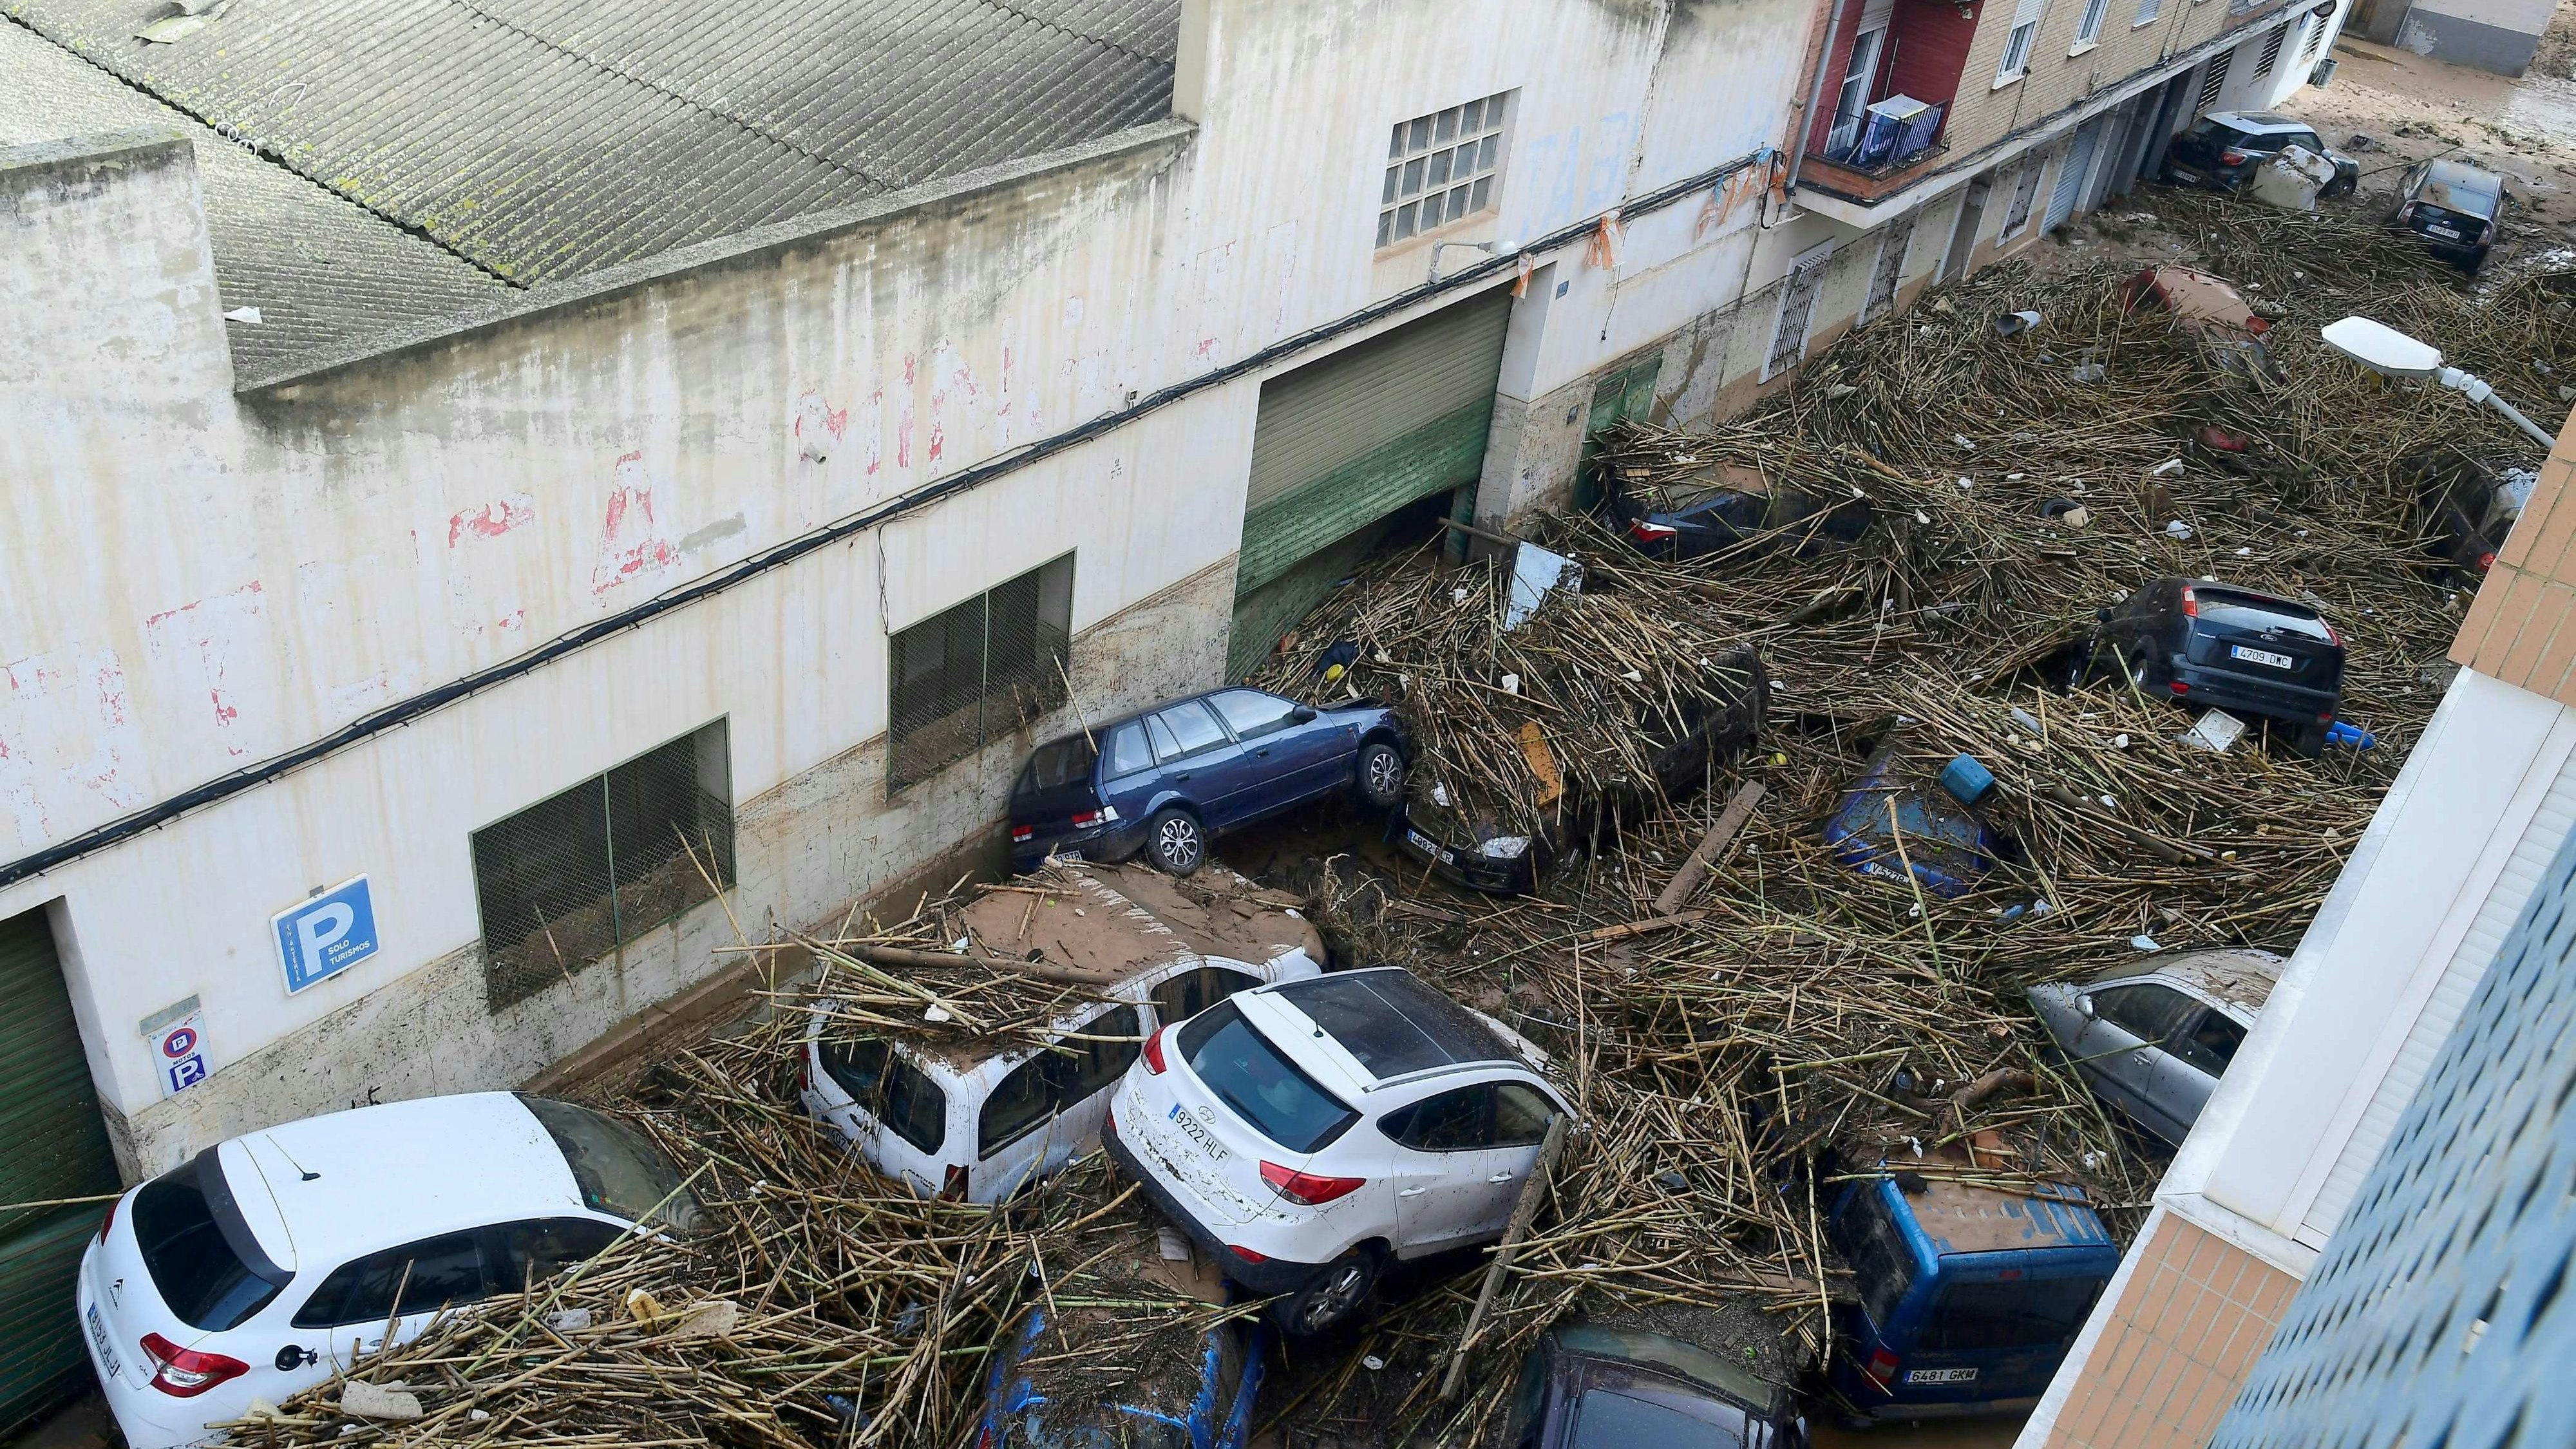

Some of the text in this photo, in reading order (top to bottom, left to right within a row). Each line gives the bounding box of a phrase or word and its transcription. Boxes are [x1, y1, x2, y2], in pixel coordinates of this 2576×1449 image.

[2240, 650, 2288, 667] 4709 DWC
[296, 901, 354, 977] P
[328, 939, 350, 956] SOLO
[329, 940, 371, 965] TURISMOS
[173, 1051, 196, 1066] MOTOS
[175, 1060, 199, 1089] P
[1176, 1112, 1228, 1162] 9222 HLF
[1911, 1370, 1944, 1381] 6481
